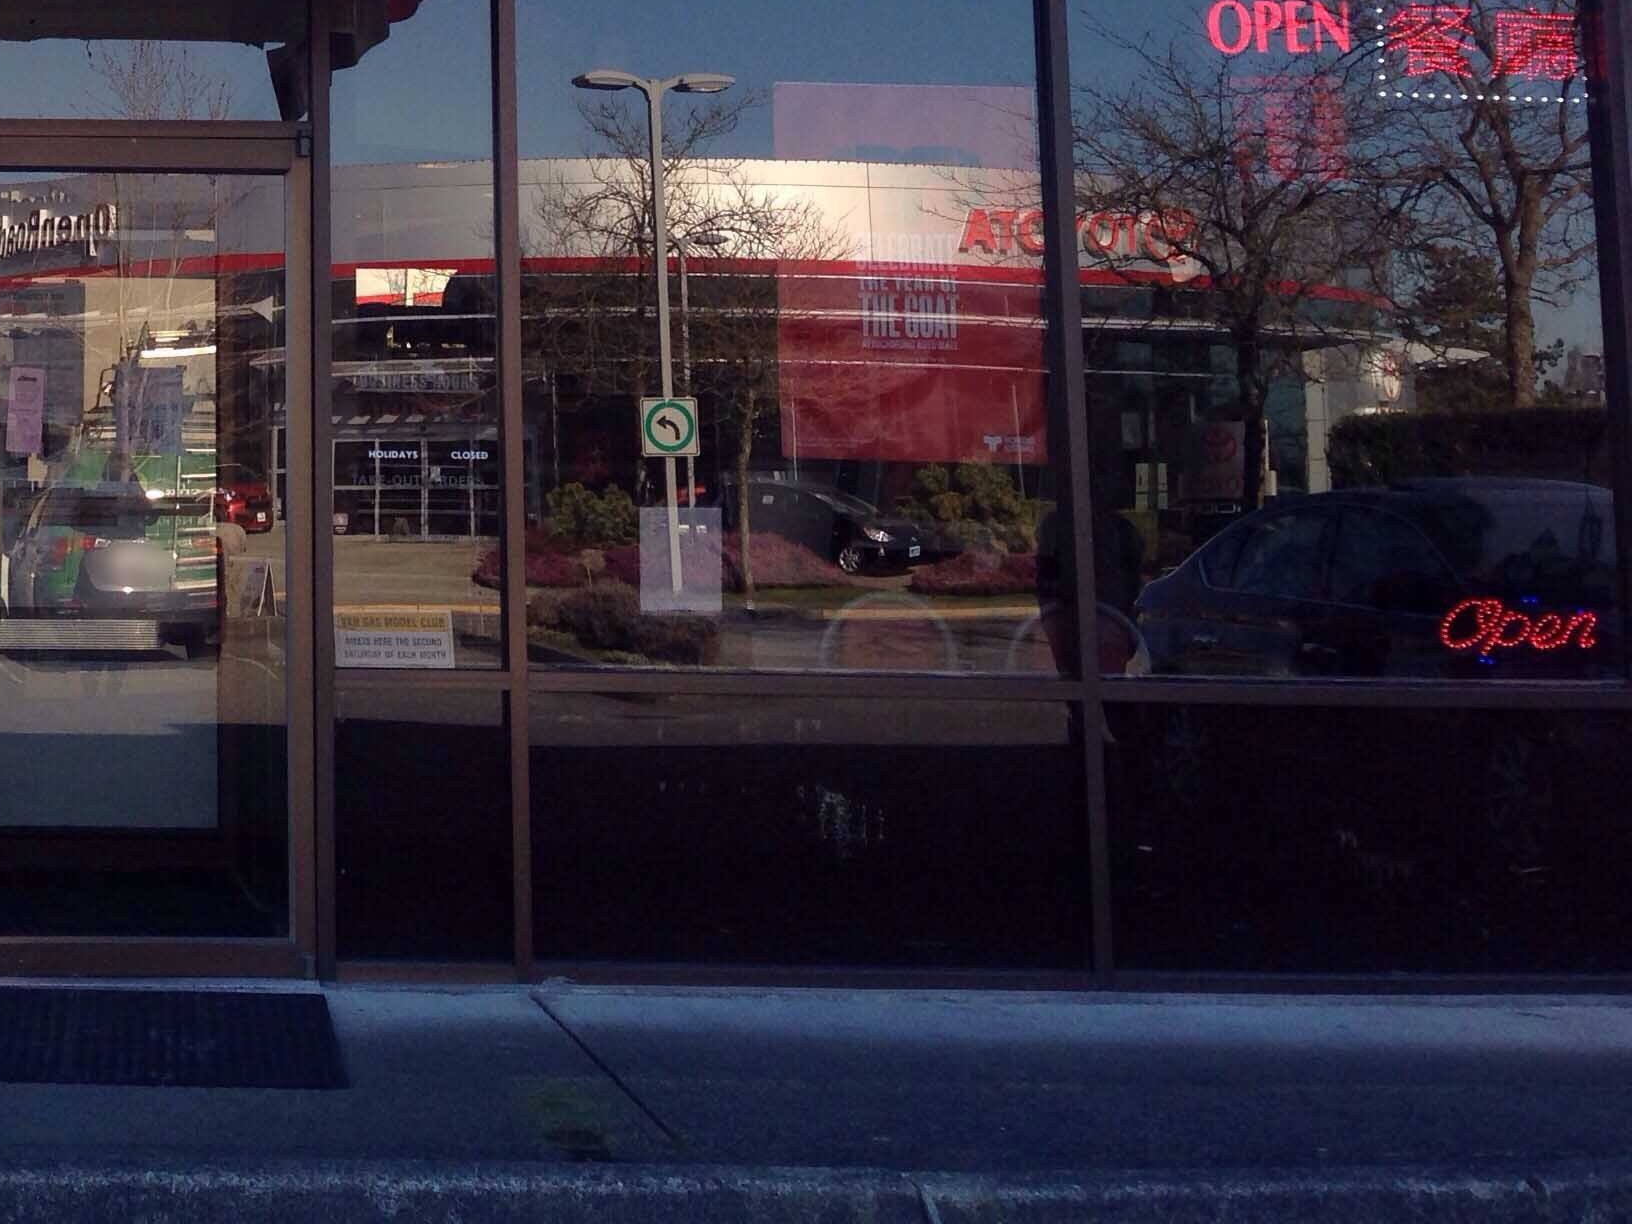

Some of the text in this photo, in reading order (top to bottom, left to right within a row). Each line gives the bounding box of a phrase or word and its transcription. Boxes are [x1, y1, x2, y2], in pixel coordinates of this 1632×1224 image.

[859, 293, 959, 338] THE GOAT
[368, 450, 489, 460] HOLIDAYS CLOSED
[1440, 597, 1597, 656] Open
